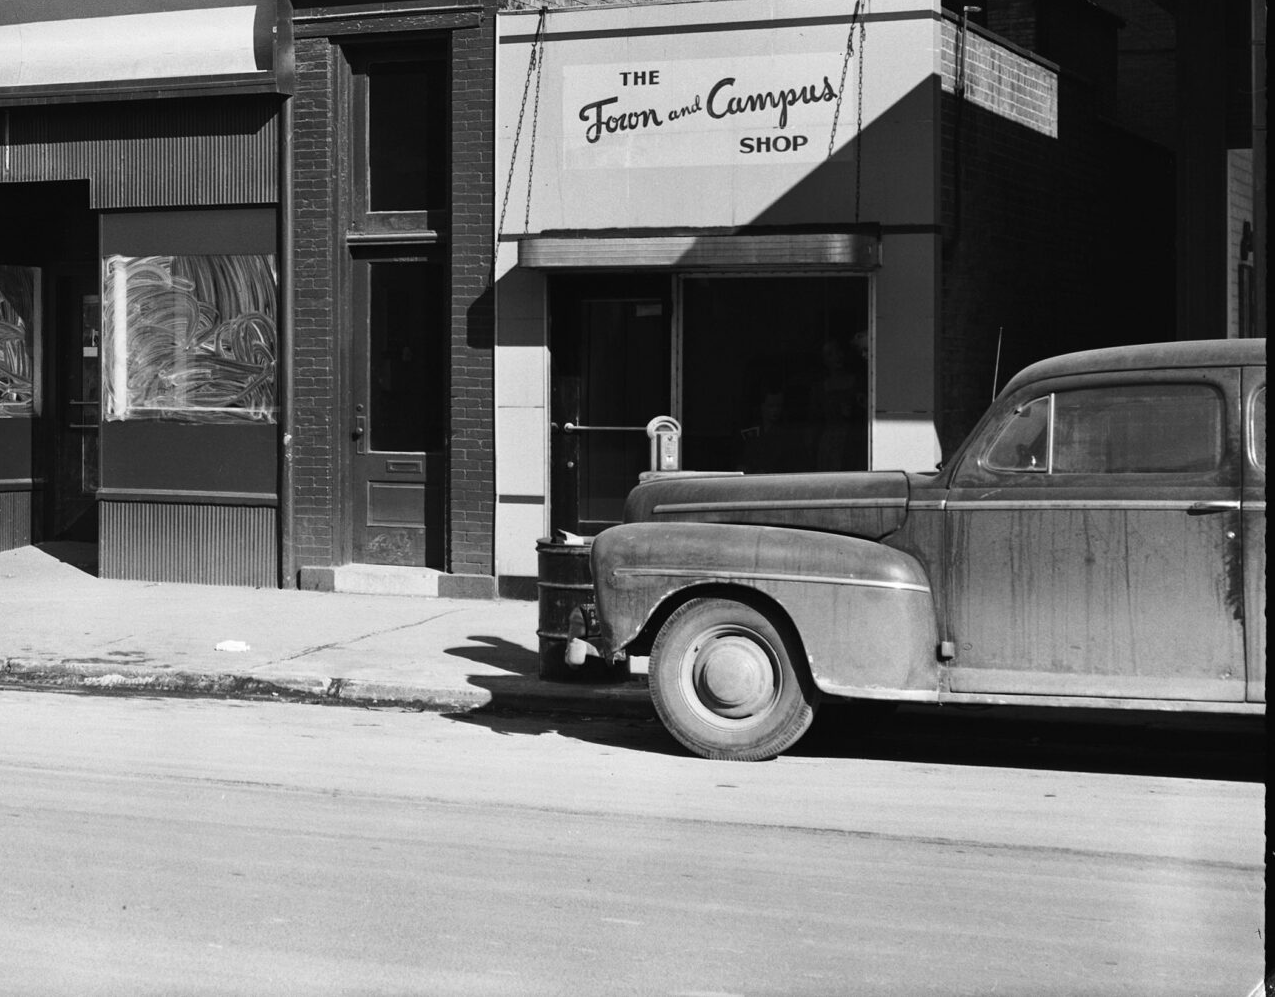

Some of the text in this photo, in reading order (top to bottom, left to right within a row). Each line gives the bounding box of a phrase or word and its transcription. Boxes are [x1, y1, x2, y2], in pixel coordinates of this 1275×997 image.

[619, 70, 660, 87] THE
[579, 76, 838, 144] Town and Campus
[739, 135, 808, 154] SHOP
